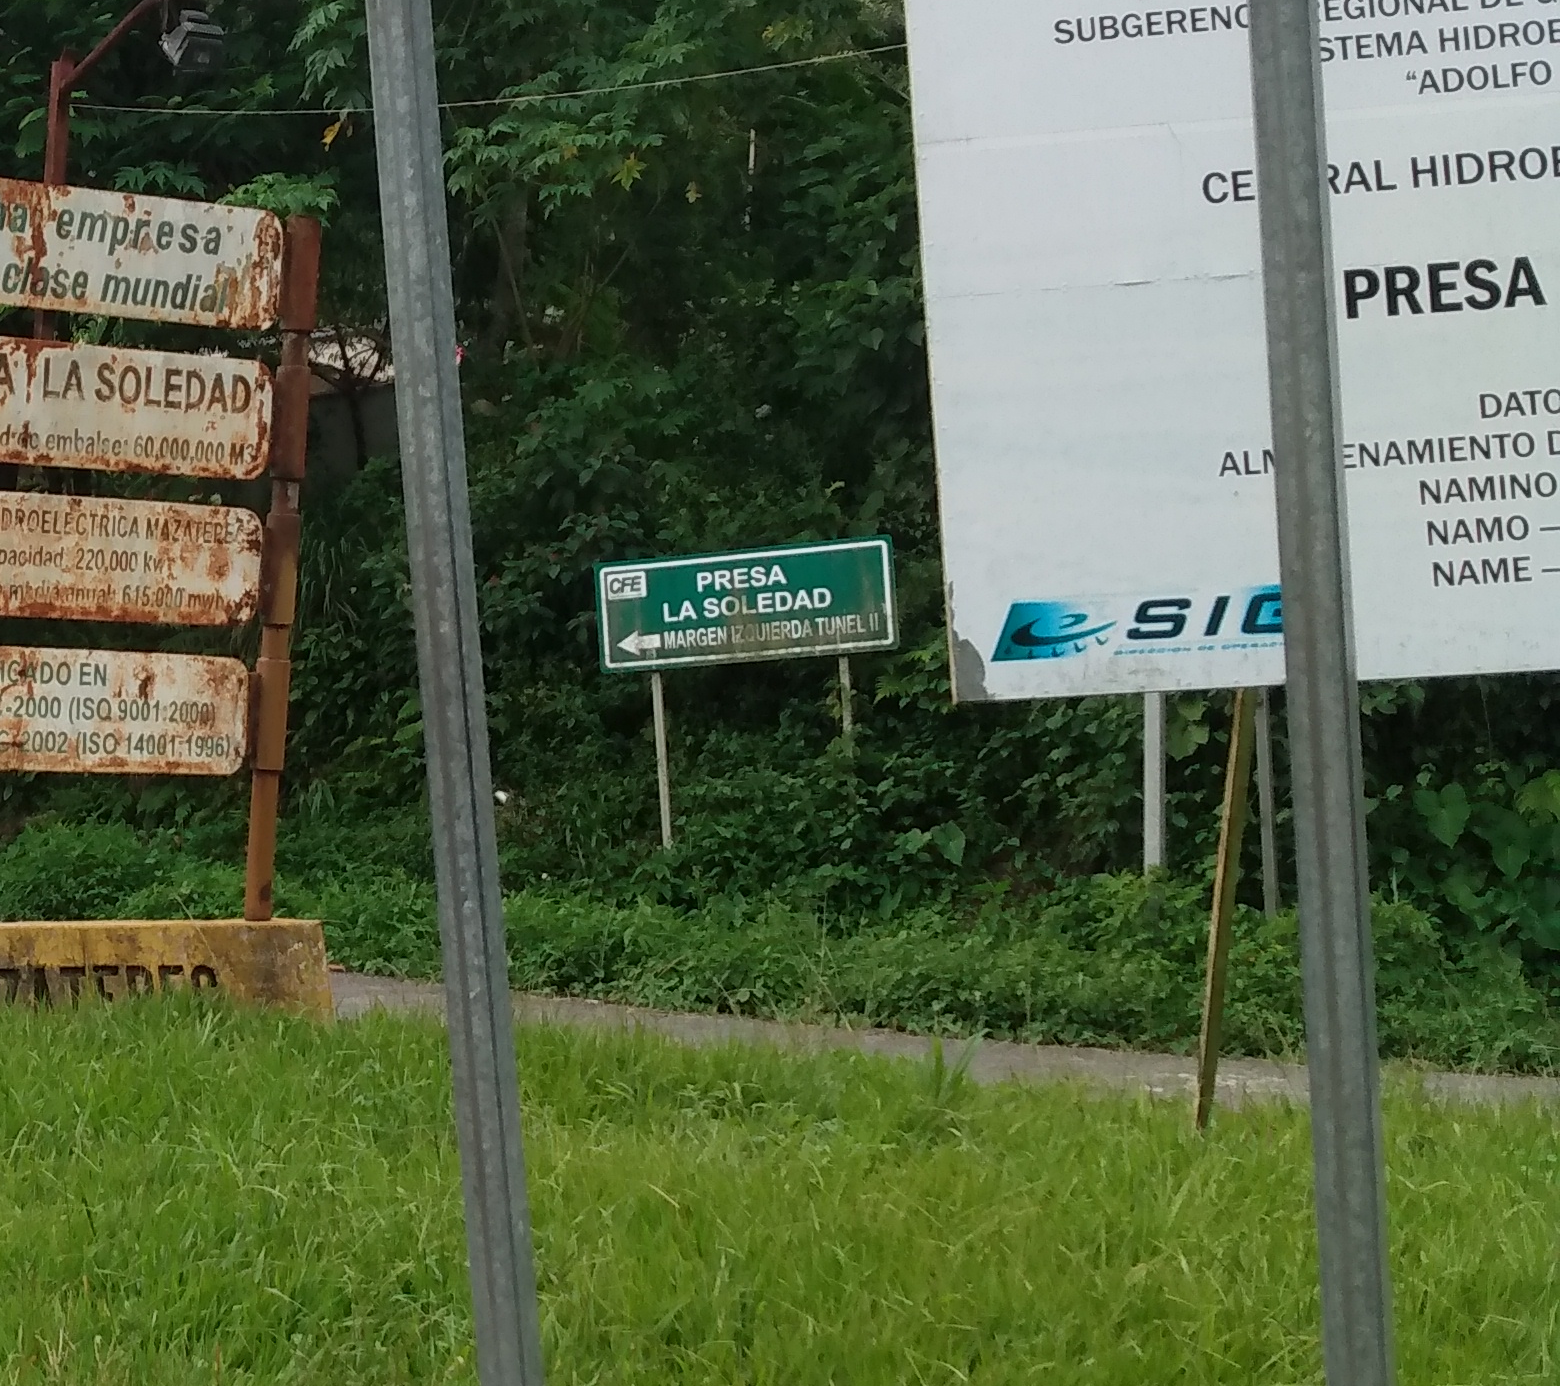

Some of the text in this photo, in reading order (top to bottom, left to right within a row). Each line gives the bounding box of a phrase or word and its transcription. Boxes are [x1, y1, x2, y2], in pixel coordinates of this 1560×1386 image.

[1054, 4, 1249, 44] SUBGERENC
[1319, 30, 1428, 63] STEMA
[1202, 160, 1397, 205] CERAL
[55, 208, 222, 256] empresa
[2, 260, 88, 300] clase
[99, 269, 230, 315] mundial
[1344, 256, 1547, 319] PRESA
[43, 357, 85, 401] LA
[1419, 472, 1557, 505] NAMINO
[1427, 515, 1529, 546] NAMO
[609, 565, 787, 595] CFE PRESA
[1433, 556, 1532, 587] NAME
[662, 588, 832, 623] LA SOLEDAD
[663, 626, 727, 650] MARGEN
[732, 619, 813, 644] IZQUIERDA
[815, 614, 865, 637] TUNEL
[80, 663, 108, 688] EN
